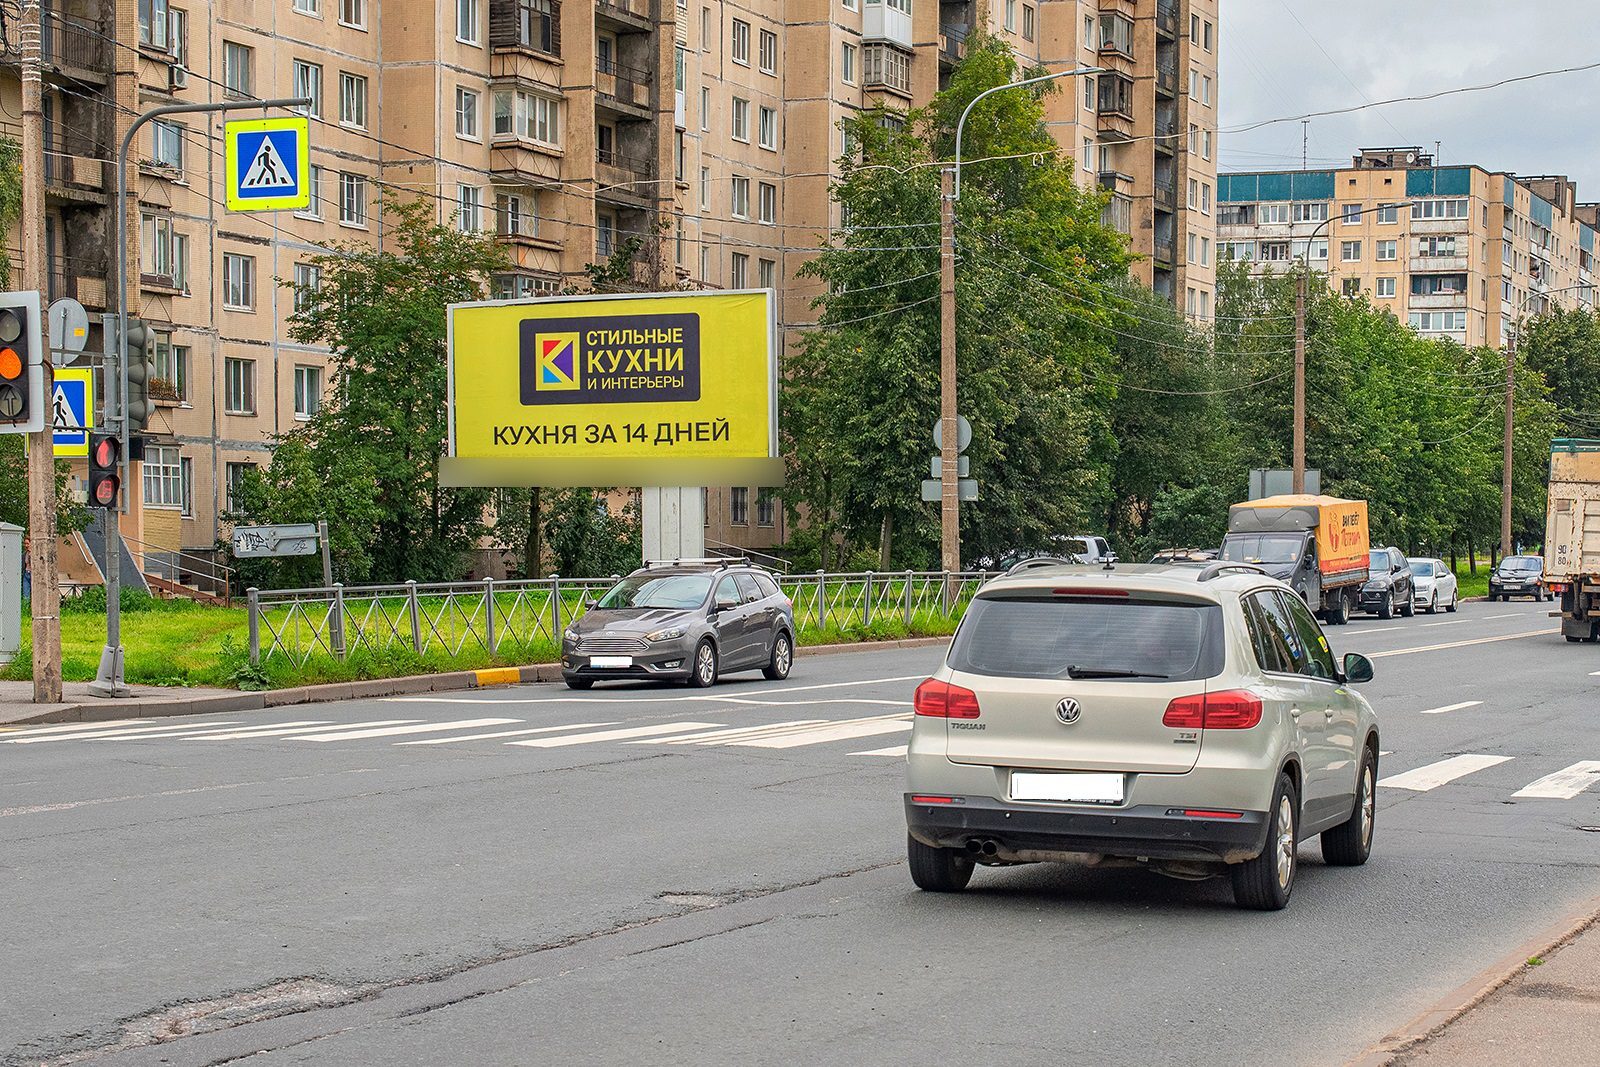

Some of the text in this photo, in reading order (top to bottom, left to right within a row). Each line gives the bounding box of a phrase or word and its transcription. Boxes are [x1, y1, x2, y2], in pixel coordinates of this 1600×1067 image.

[586, 328, 683, 346] СТИЛЬНЫЕ
[587, 348, 684, 374] КУХНИ
[587, 376, 684, 390] И ИНТЕРЬЕРЫ
[493, 417, 730, 446] КУХНЯ ЗА 14 ДНЕЙ
[1557, 544, 1567, 554] 90
[1557, 556, 1567, 565] 80
